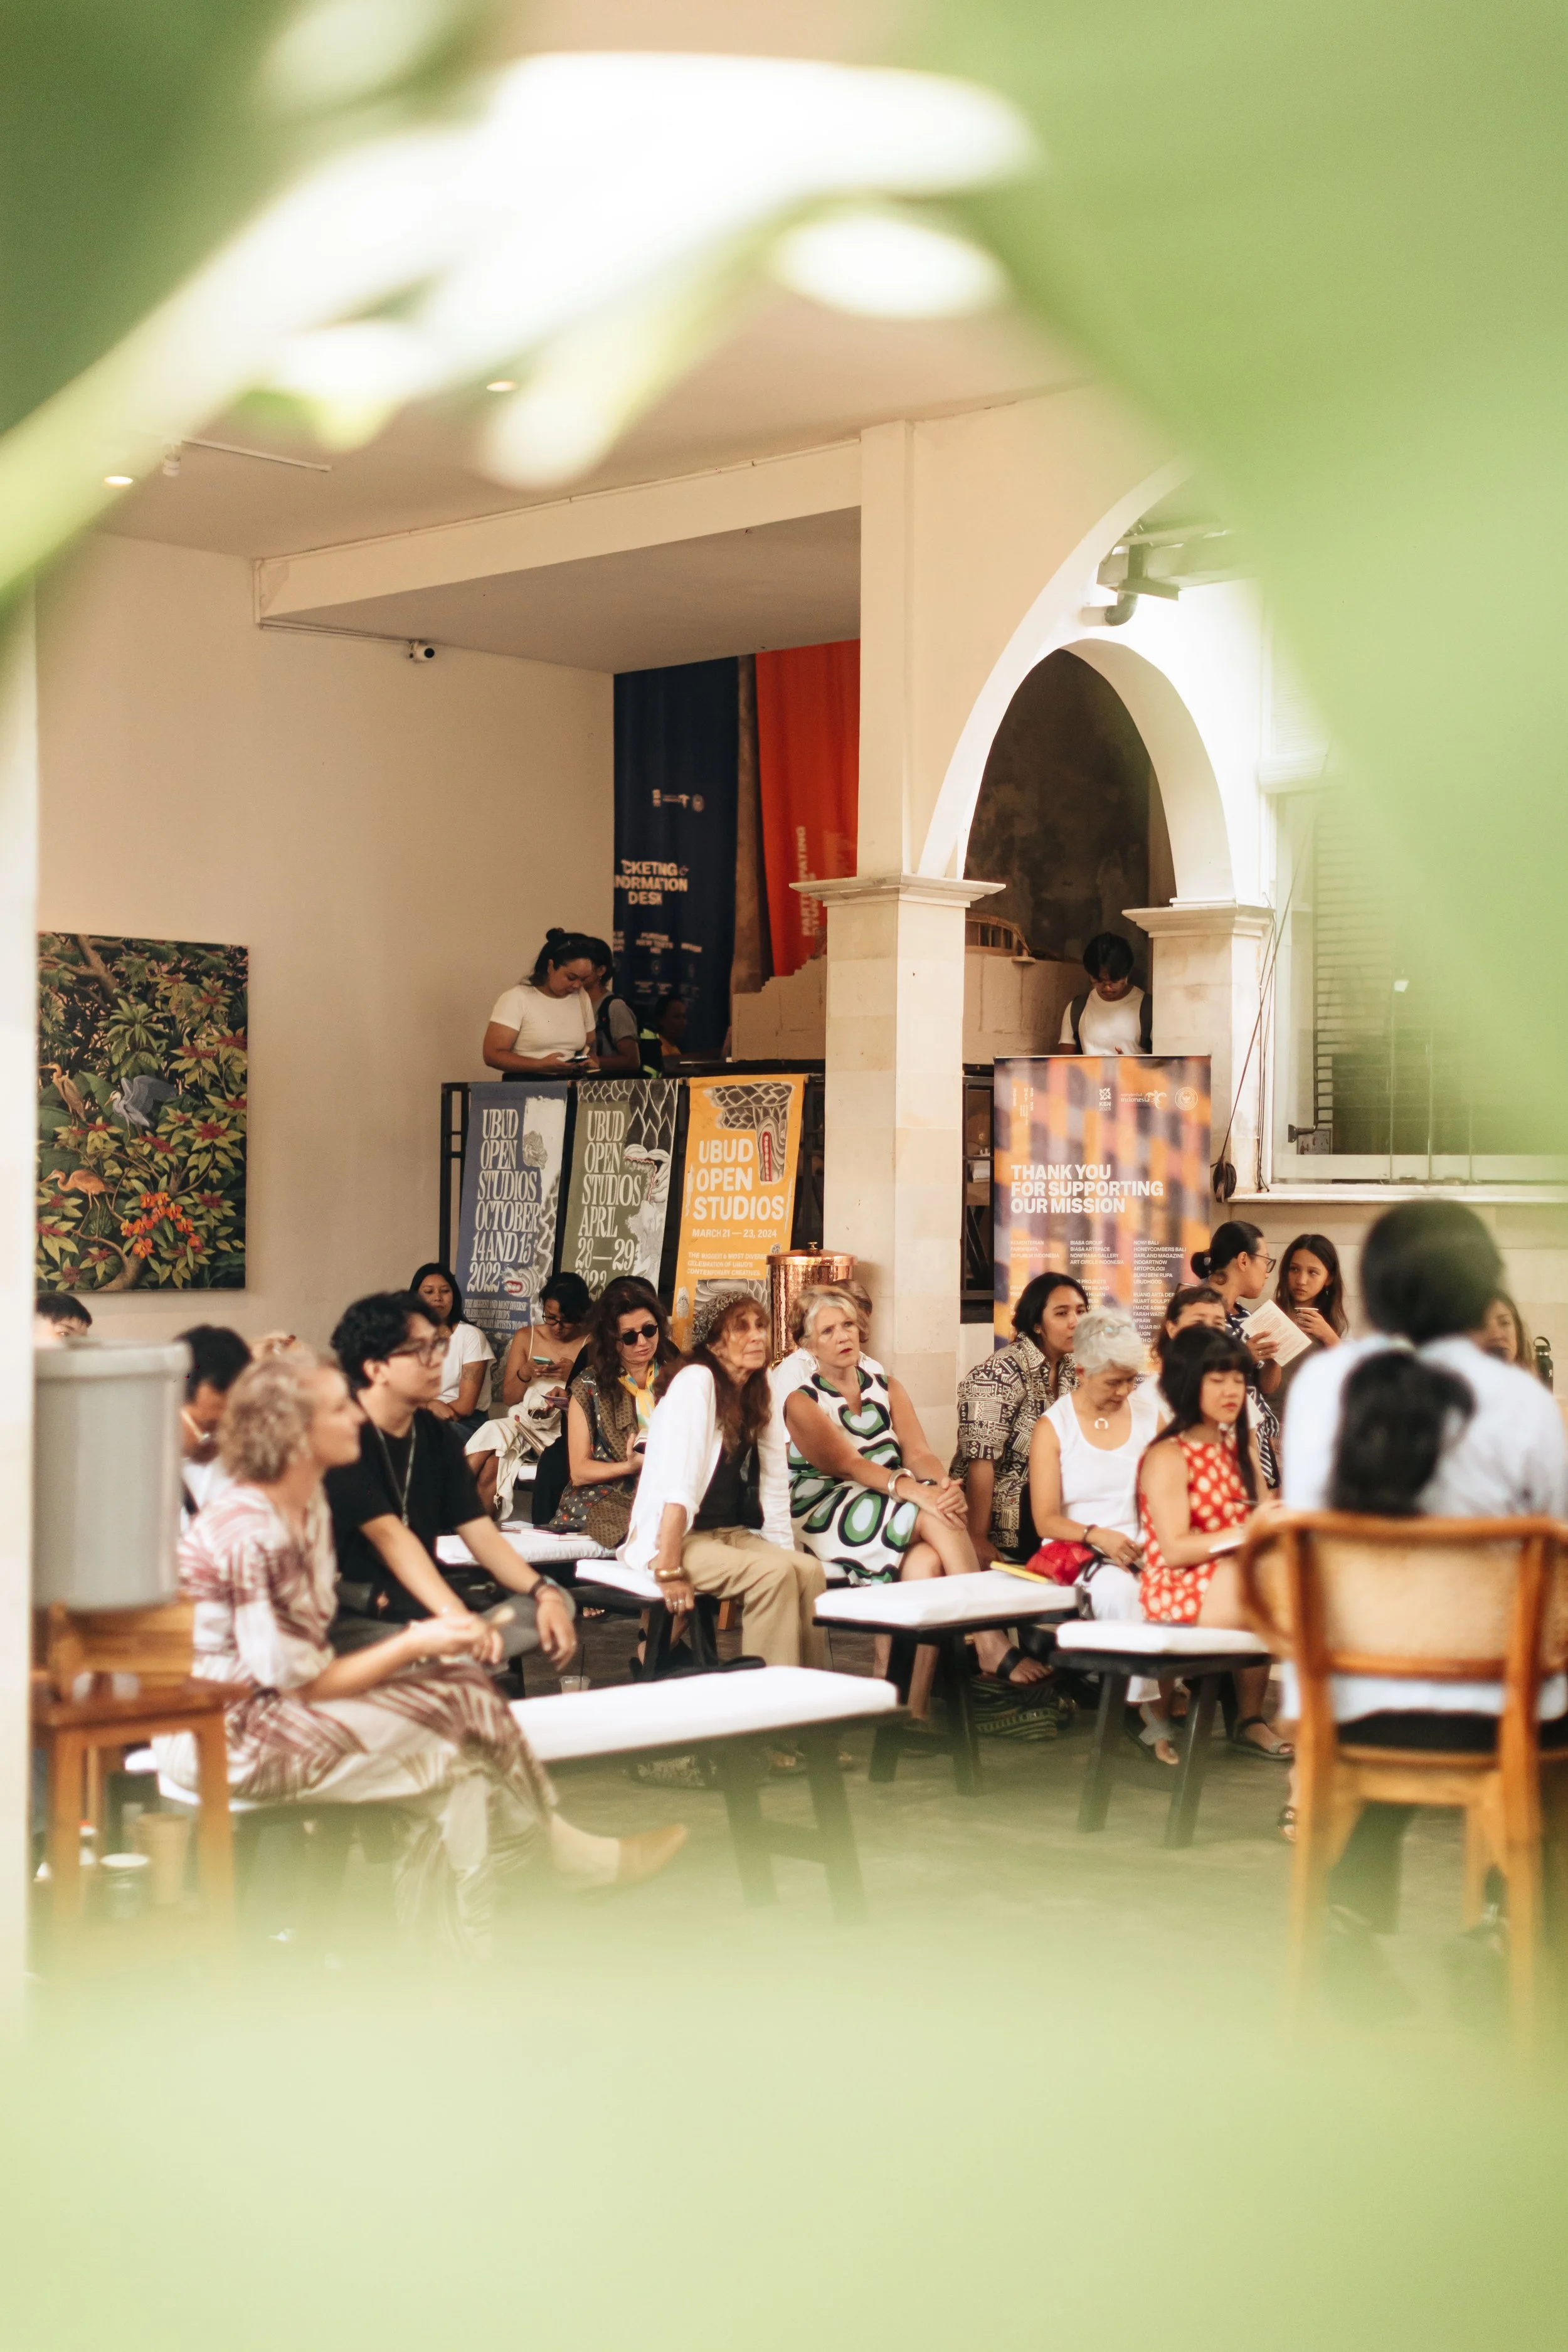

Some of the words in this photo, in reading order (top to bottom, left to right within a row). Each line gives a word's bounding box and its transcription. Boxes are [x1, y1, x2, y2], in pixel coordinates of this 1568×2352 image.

[482, 1109, 519, 1140] UBUD
[587, 1111, 625, 1142] UBUD
[480, 1139, 518, 1170] OPEN
[584, 1142, 623, 1173] OPEN
[699, 1138, 753, 1163] UBUD
[477, 1170, 538, 1202] STUDIOS
[696, 1167, 753, 1191] OPEN
[1011, 1164, 1072, 1180] THANK
[1075, 1164, 1111, 1180] YOU
[582, 1173, 642, 1207] STUDIOS
[1011, 1181, 1046, 1197] FOR
[1048, 1180, 1163, 1197] SUPPORTING
[475, 1200, 541, 1232] OCTOBER
[578, 1205, 618, 1237] APRIL
[693, 1195, 784, 1221] STUDIOS
[1010, 1198, 1047, 1213] OUR
[1051, 1198, 1125, 1214] MISSION
[471, 1231, 486, 1261] 14
[485, 1231, 518, 1263] AND
[517, 1233, 533, 1264] 15
[692, 1229, 721, 1237] MARCH
[723, 1229, 730, 1237] 21
[743, 1229, 755, 1239] 23,
[758, 1229, 777, 1237] 2024
[467, 1261, 502, 1293] 2022
